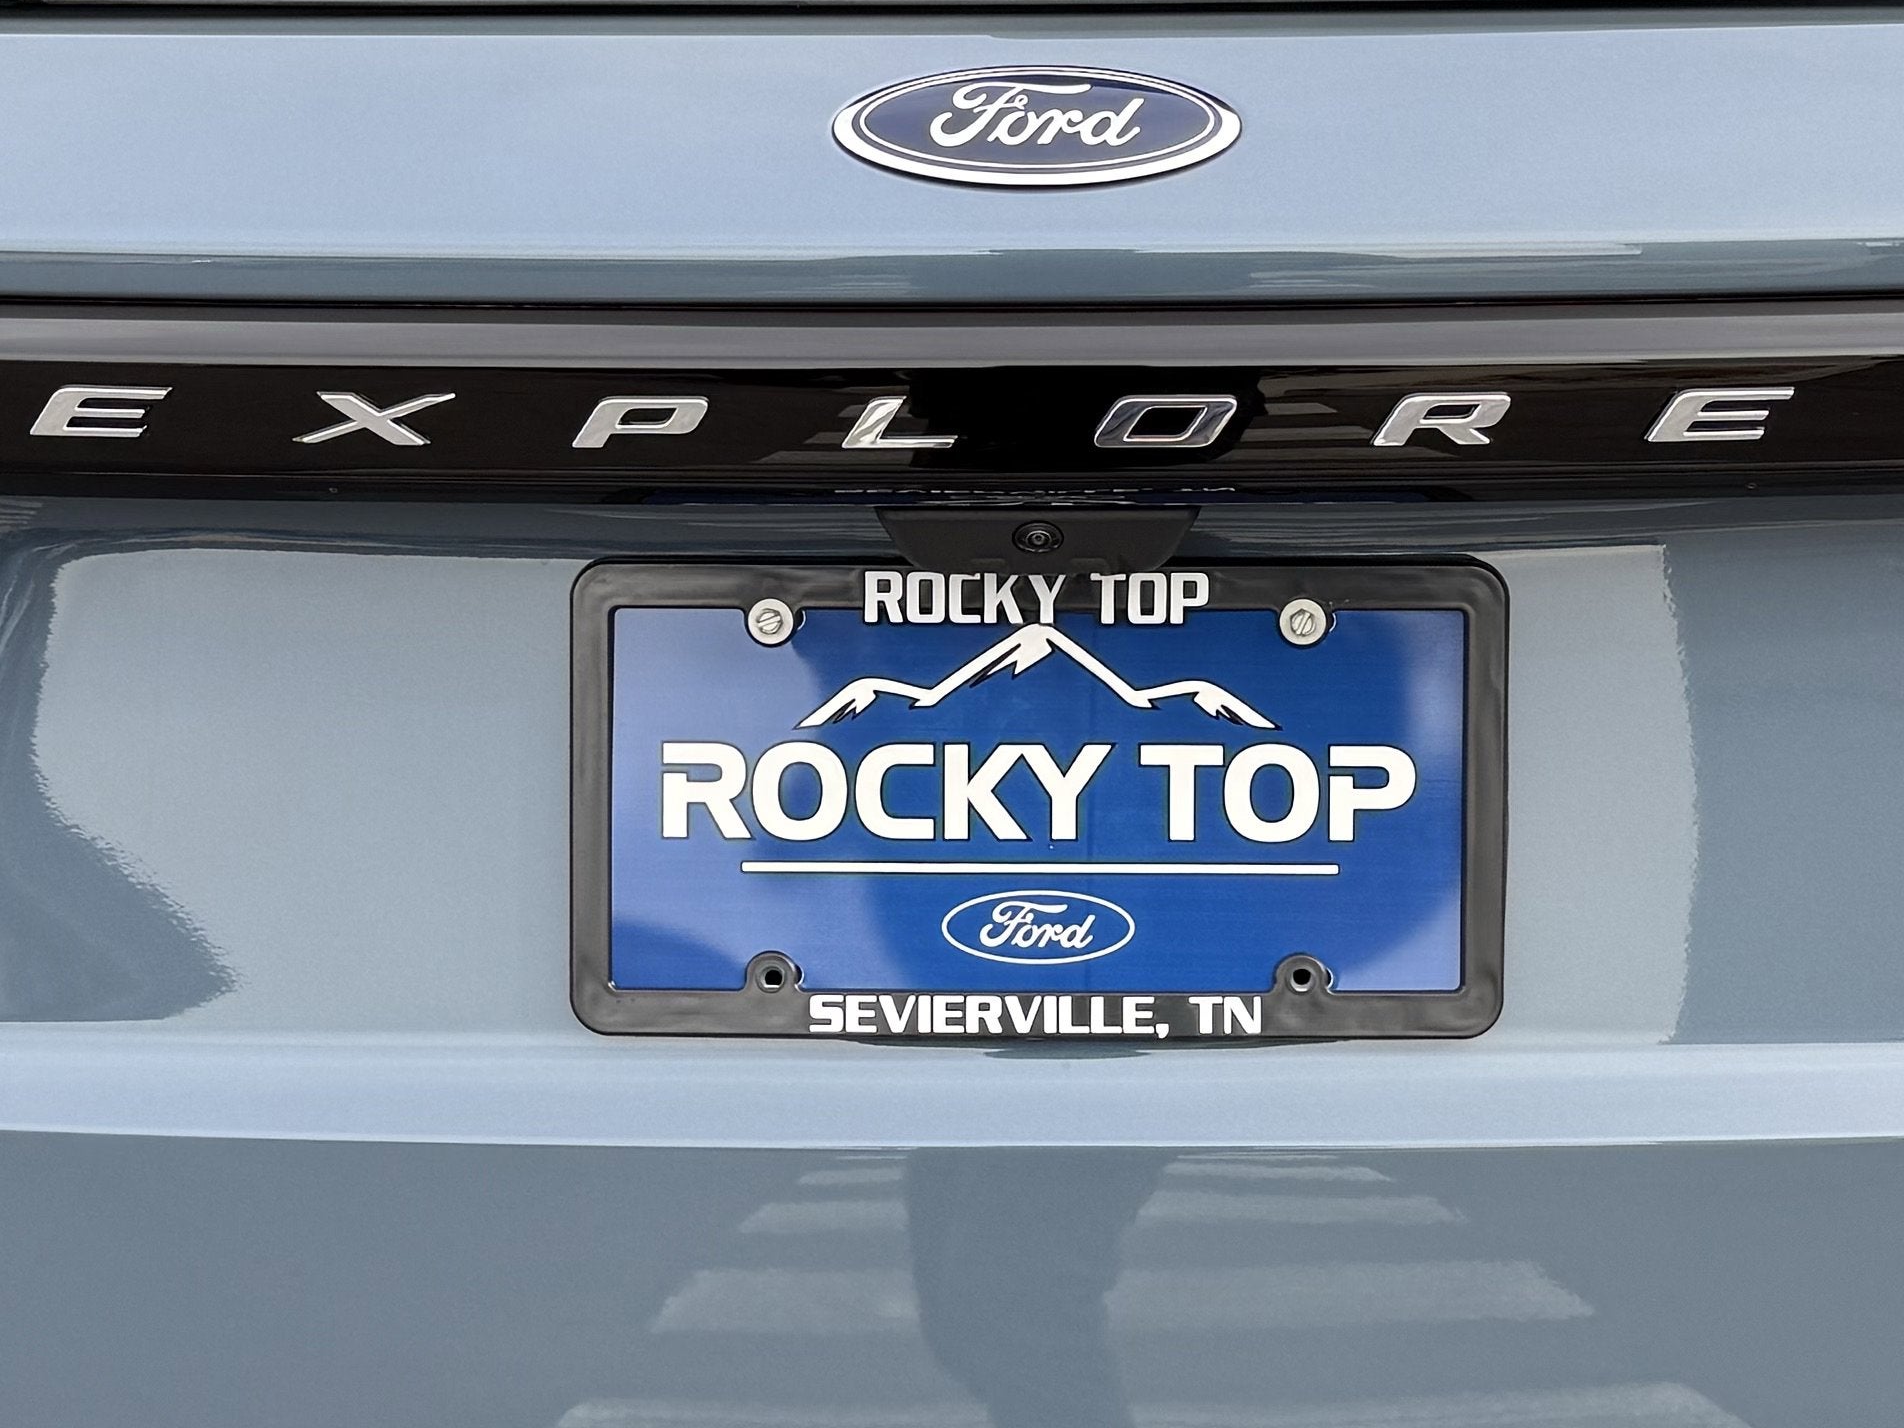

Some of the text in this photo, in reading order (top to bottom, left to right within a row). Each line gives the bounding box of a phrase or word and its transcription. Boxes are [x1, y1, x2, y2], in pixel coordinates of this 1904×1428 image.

[929, 81, 1145, 147] Ford
[864, 571, 1210, 624] ROCKY TOP
[661, 742, 1417, 842] ROCKY TOP
[979, 900, 1096, 949] Ford
[808, 994, 1262, 1039] SEVIERVILLE, TN
